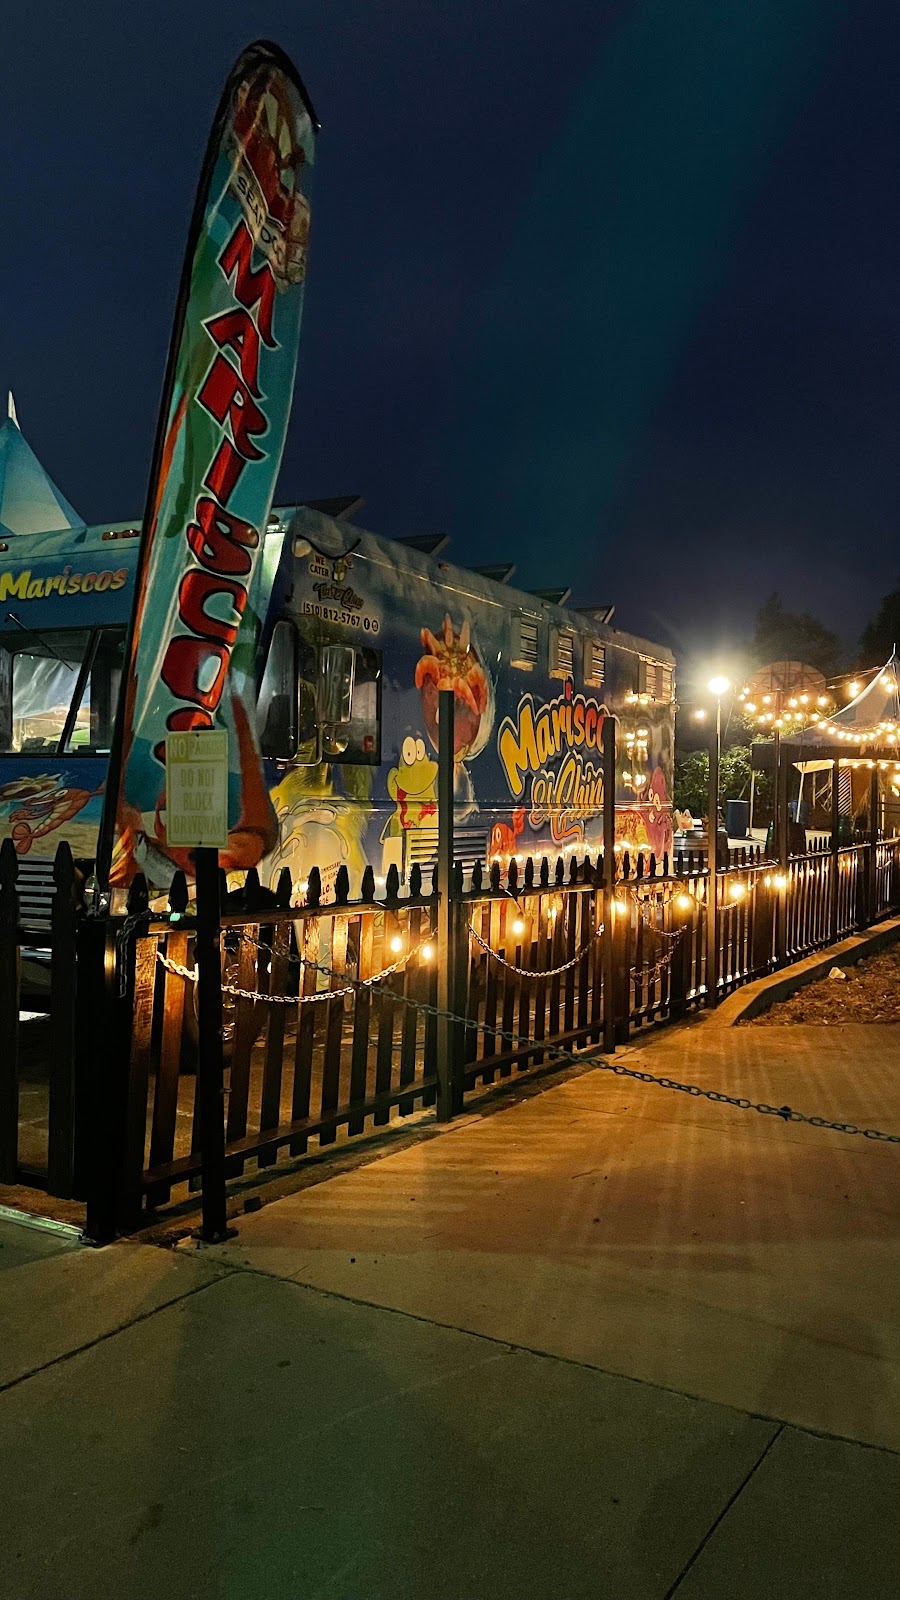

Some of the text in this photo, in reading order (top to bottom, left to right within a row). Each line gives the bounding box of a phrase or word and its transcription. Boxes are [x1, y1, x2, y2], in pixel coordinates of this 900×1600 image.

[309, 564, 329, 577] CATER
[315, 555, 325, 566] WE
[0, 565, 129, 601] Mariscos
[170, 737, 225, 759] NO PARKING
[500, 681, 616, 796] Marisco
[180, 766, 215, 787] DO NOT
[182, 792, 214, 811] BLOCK
[552, 757, 605, 841] Chin
[173, 814, 222, 834] DRIVEWAY
